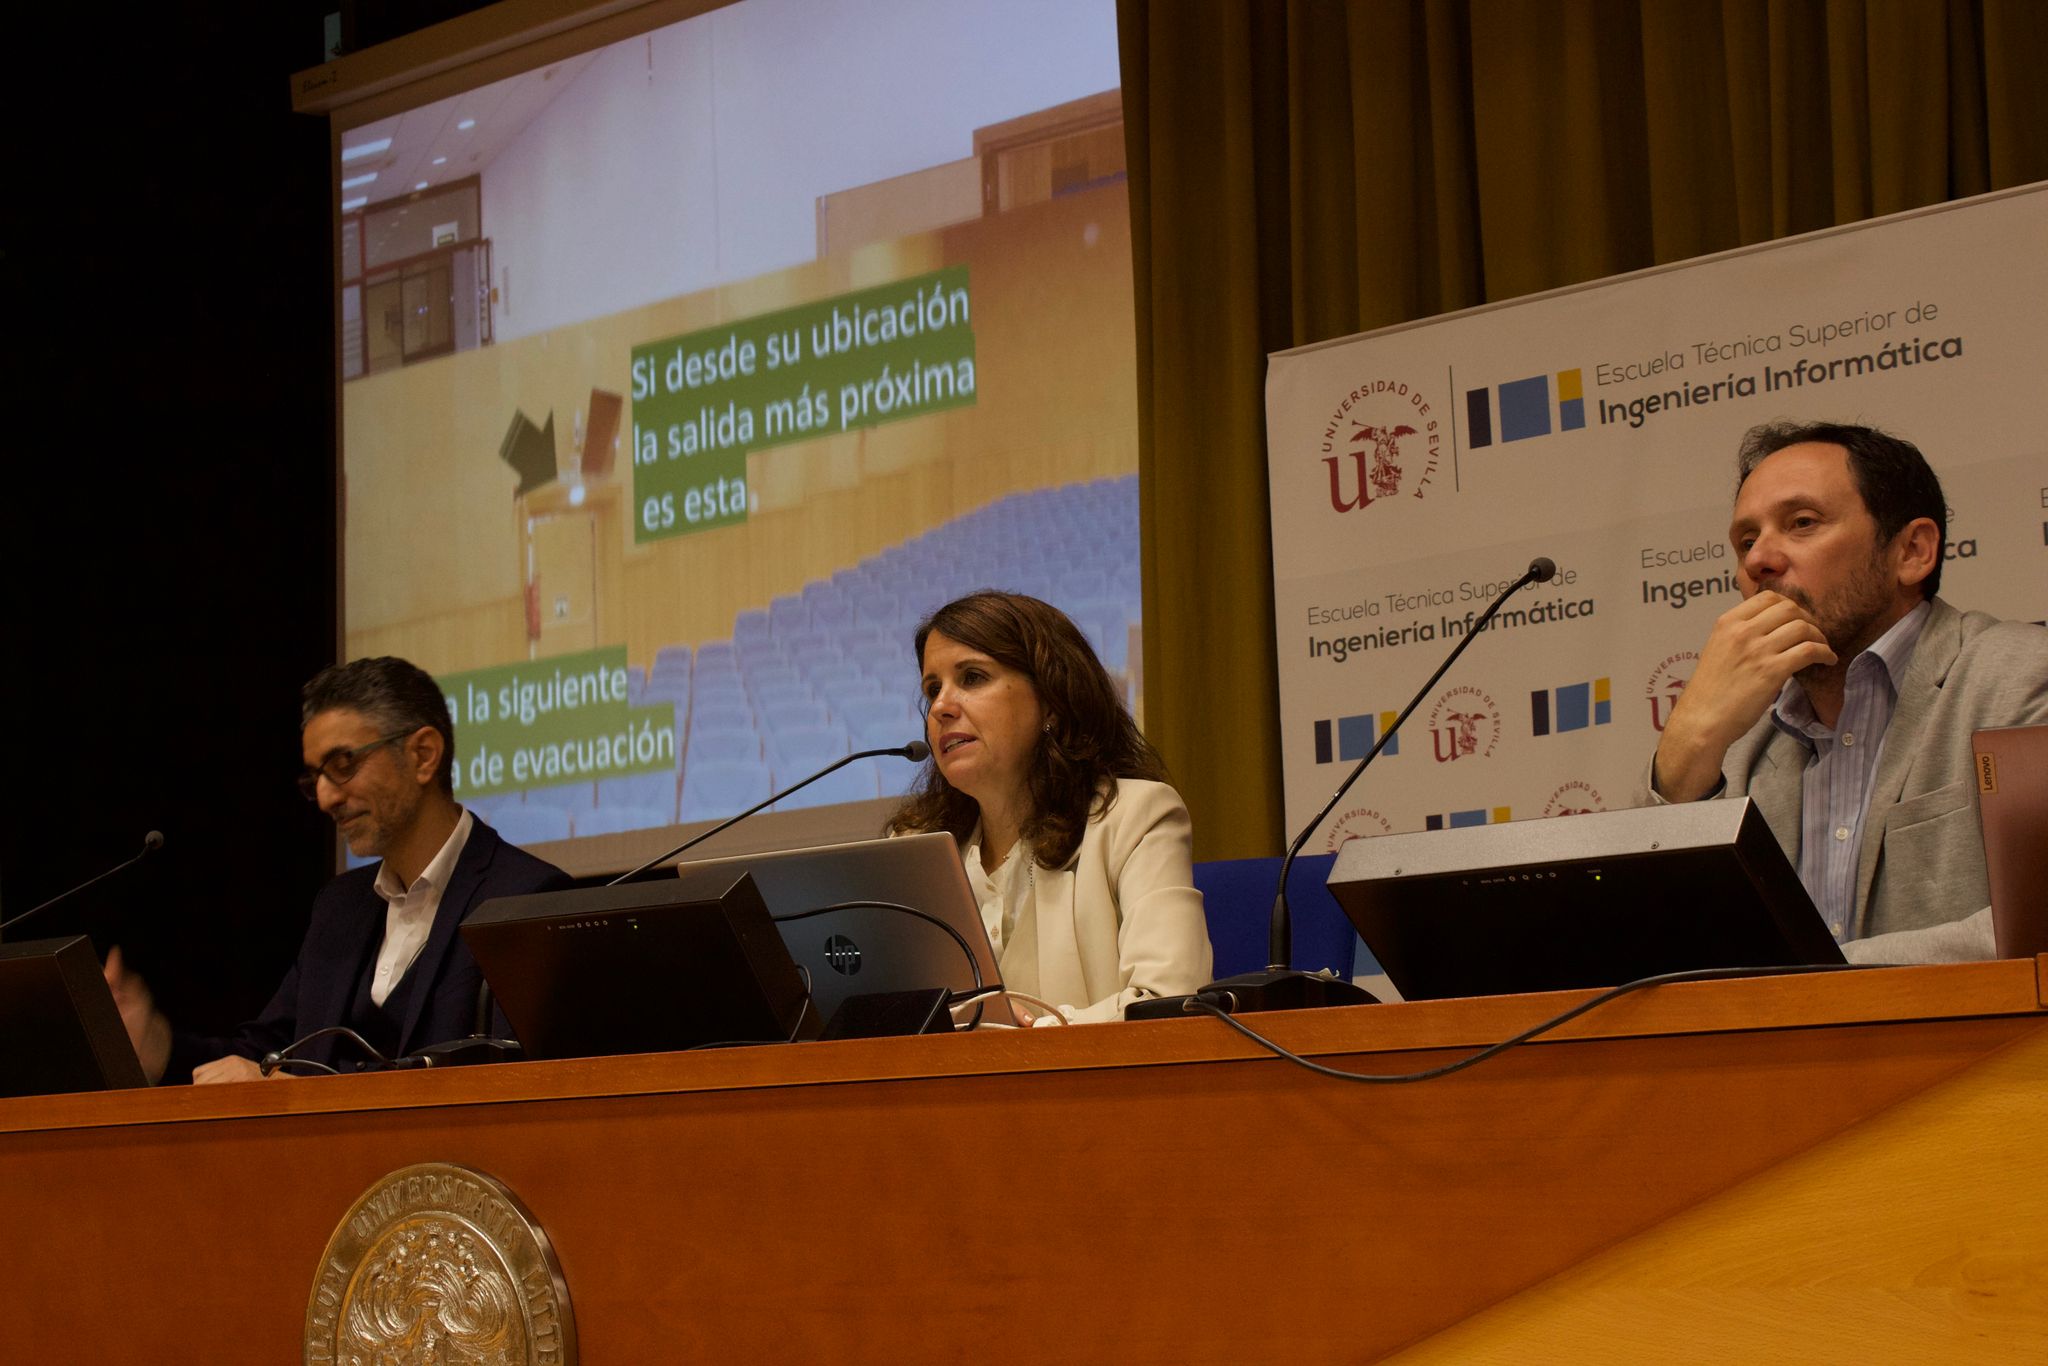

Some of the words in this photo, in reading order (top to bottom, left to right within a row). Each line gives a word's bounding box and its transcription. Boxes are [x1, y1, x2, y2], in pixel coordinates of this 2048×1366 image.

[631, 353, 656, 402] Si
[665, 331, 757, 394] desde
[766, 327, 801, 370] su
[811, 281, 969, 359] ubicación
[1595, 350, 1684, 387] Escuela
[1692, 334, 1781, 366] Técnica
[1788, 310, 1897, 348] Superior
[1904, 301, 1939, 324] de
[1598, 372, 1756, 428] Ingeniería
[1764, 336, 1963, 393] Informática
[633, 421, 658, 467] la
[667, 400, 755, 460] salida
[764, 382, 830, 438] más
[840, 356, 975, 432] próxima
[1321, 380, 1409, 453] UNIVERSIDAD
[1411, 393, 1431, 416] DE
[1413, 420, 1440, 500] SEVILLA
[642, 491, 675, 532] es
[1641, 540, 1725, 569] Escuela
[1307, 599, 1380, 626] Escuela
[1385, 589, 1454, 614] Técnica
[1308, 621, 1435, 663] Ingeniería
[1645, 651, 1700, 694] UNIVERSIDA
[467, 681, 490, 725] la
[499, 663, 628, 726] siguiente
[1429, 686, 1482, 727] UNIVERSIDAD
[1483, 695, 1496, 710] DE
[469, 744, 504, 789] de
[512, 717, 675, 783] evacuación
[1484, 711, 1501, 758] SEVILLA
[1982, 756, 1993, 791] Lenovo
[1543, 780, 1591, 815] NIVERSIDAD
[1327, 808, 1380, 848] UNIVERSIDAD
[1380, 818, 1392, 832] DE
[829, 934, 858, 976] hp
